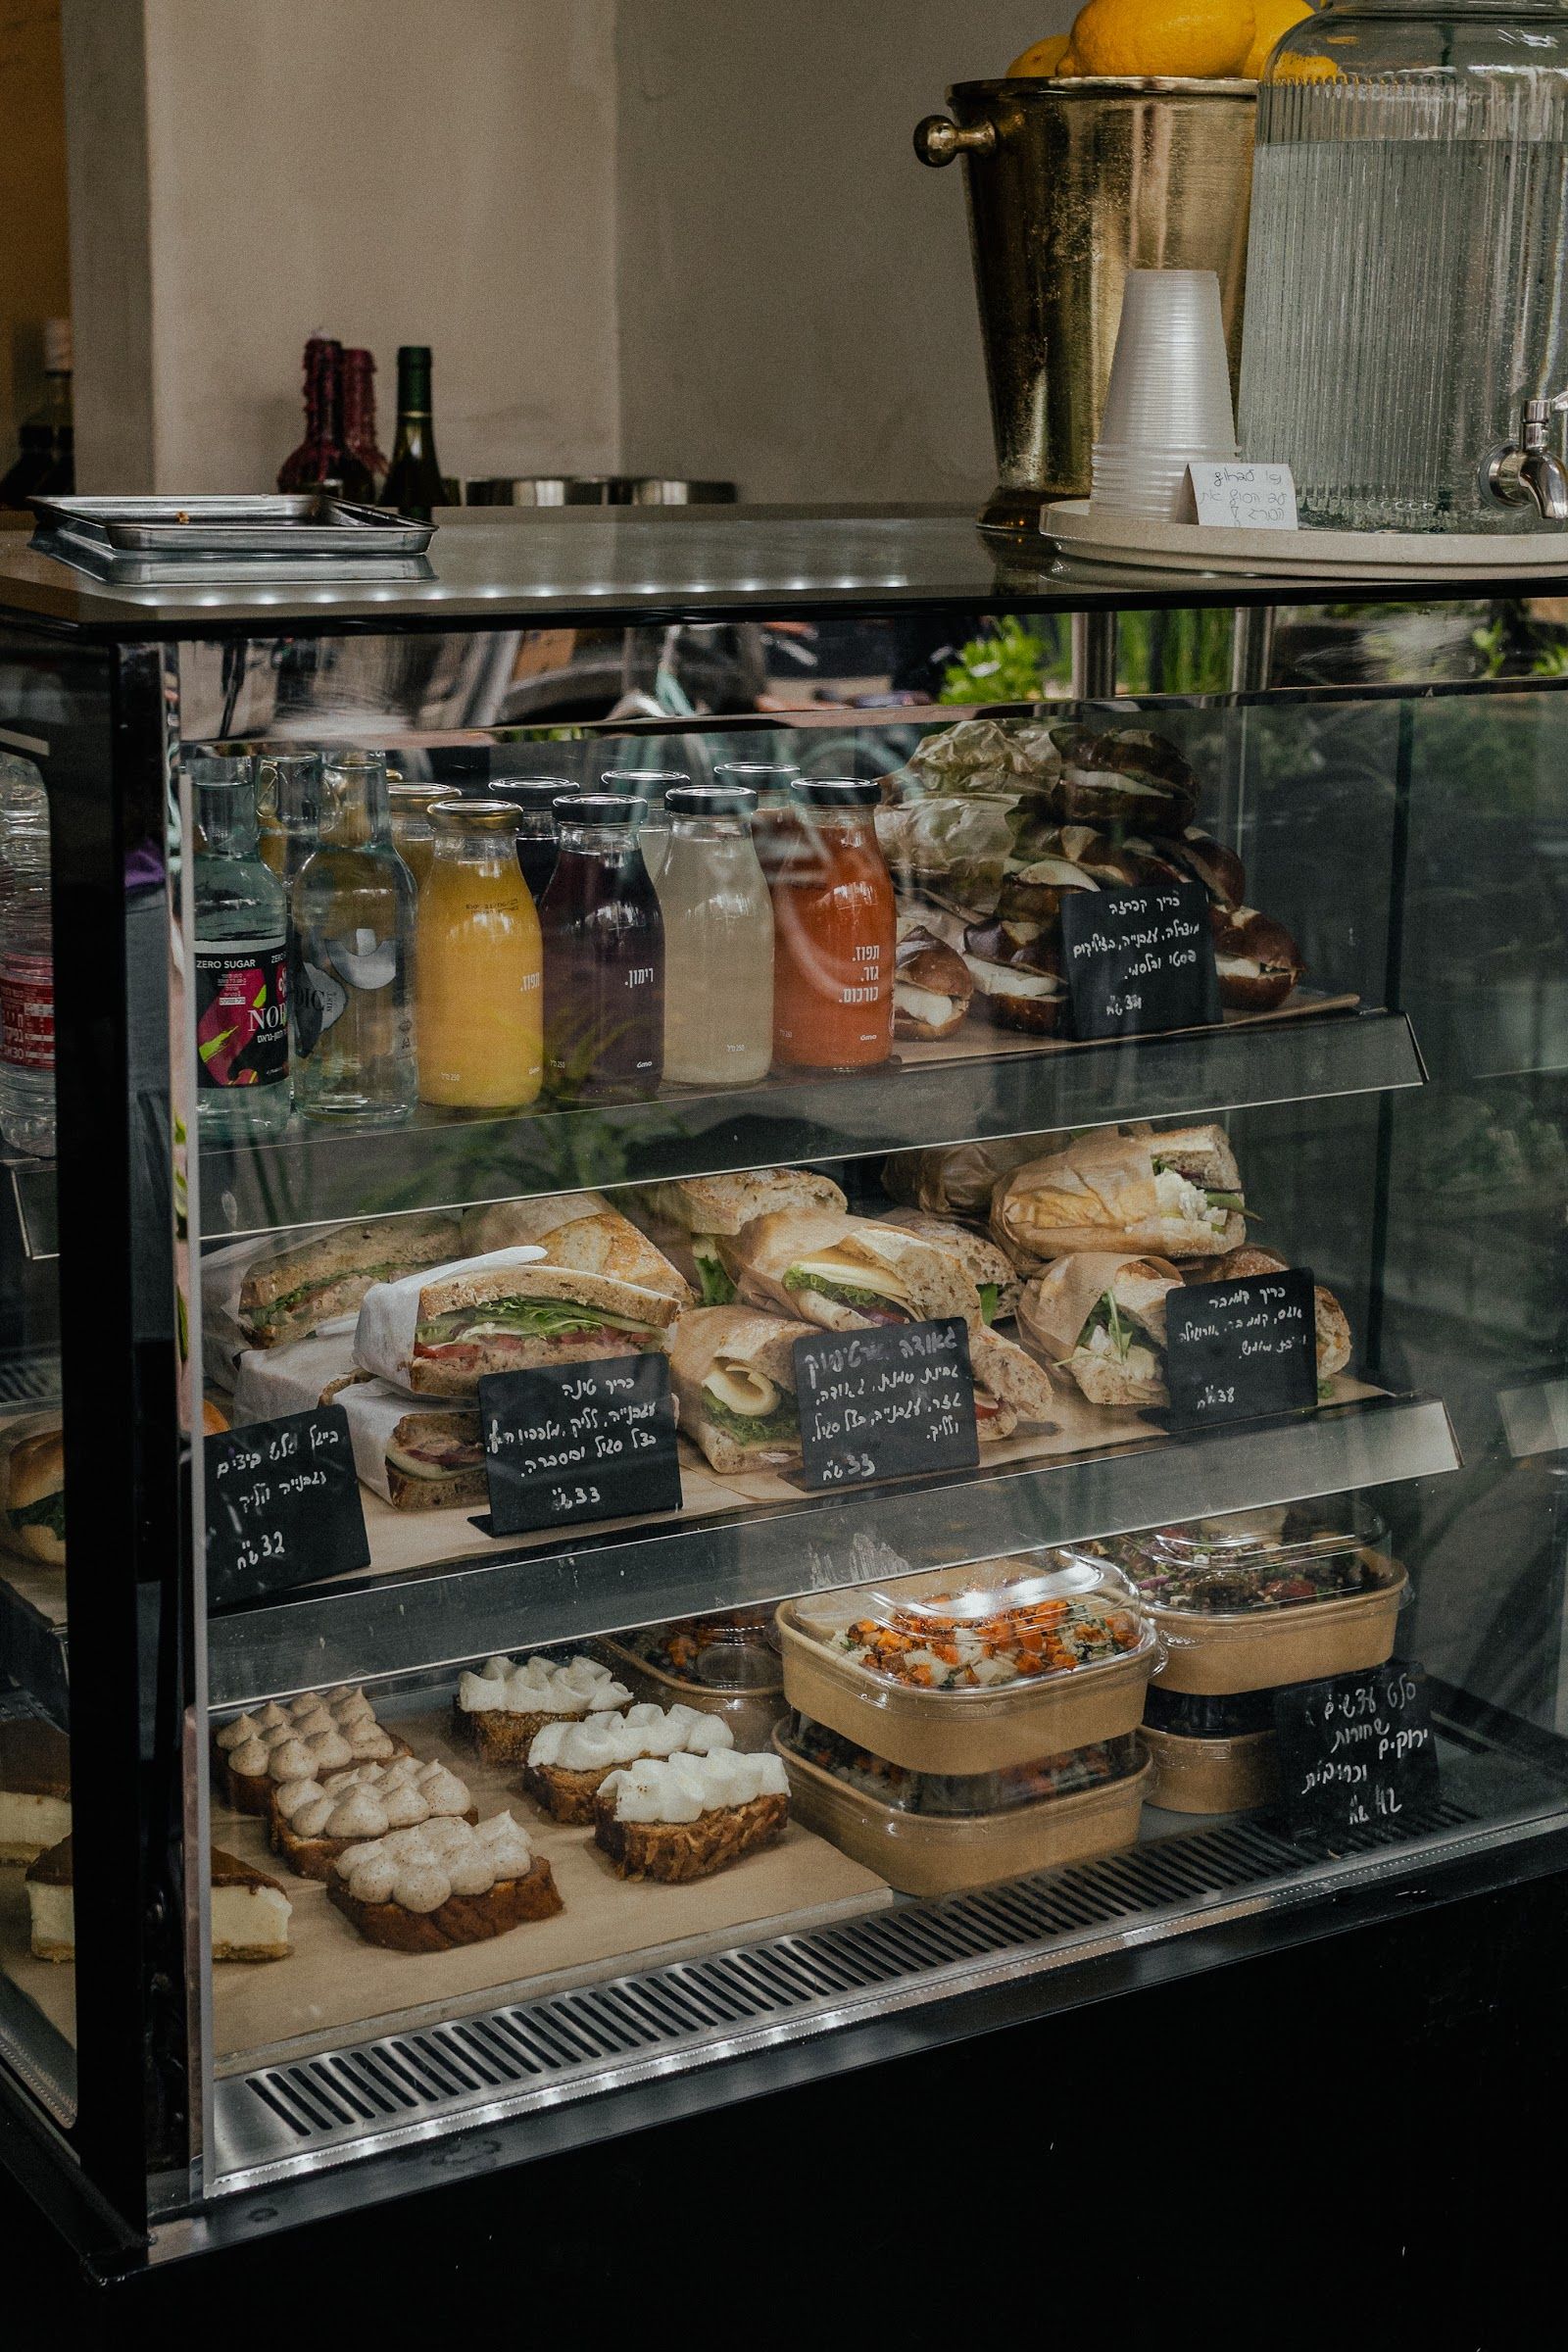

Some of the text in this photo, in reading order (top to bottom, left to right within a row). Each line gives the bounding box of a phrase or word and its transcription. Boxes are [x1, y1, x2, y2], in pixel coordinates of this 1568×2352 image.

[196, 958, 256, 969] ZERO SUGAR
[852, 945, 880, 962] תפוז.
[624, 967, 654, 989] רימון.
[860, 965, 879, 982] גזר.
[838, 987, 879, 1004] כורכום.
[1259, 1287, 1286, 1304] כריך
[605, 1377, 635, 1396] כריך
[595, 1436, 623, 1458] סגול
[631, 1427, 657, 1448] בצל
[217, 1452, 263, 1480] ביצים
[574, 1487, 601, 1504] 33
[261, 1531, 285, 1557] 32
[1387, 1672, 1416, 1710] סלט
[1330, 1718, 1391, 1754] שחורות
[1378, 1729, 1429, 1760] ירוקים
